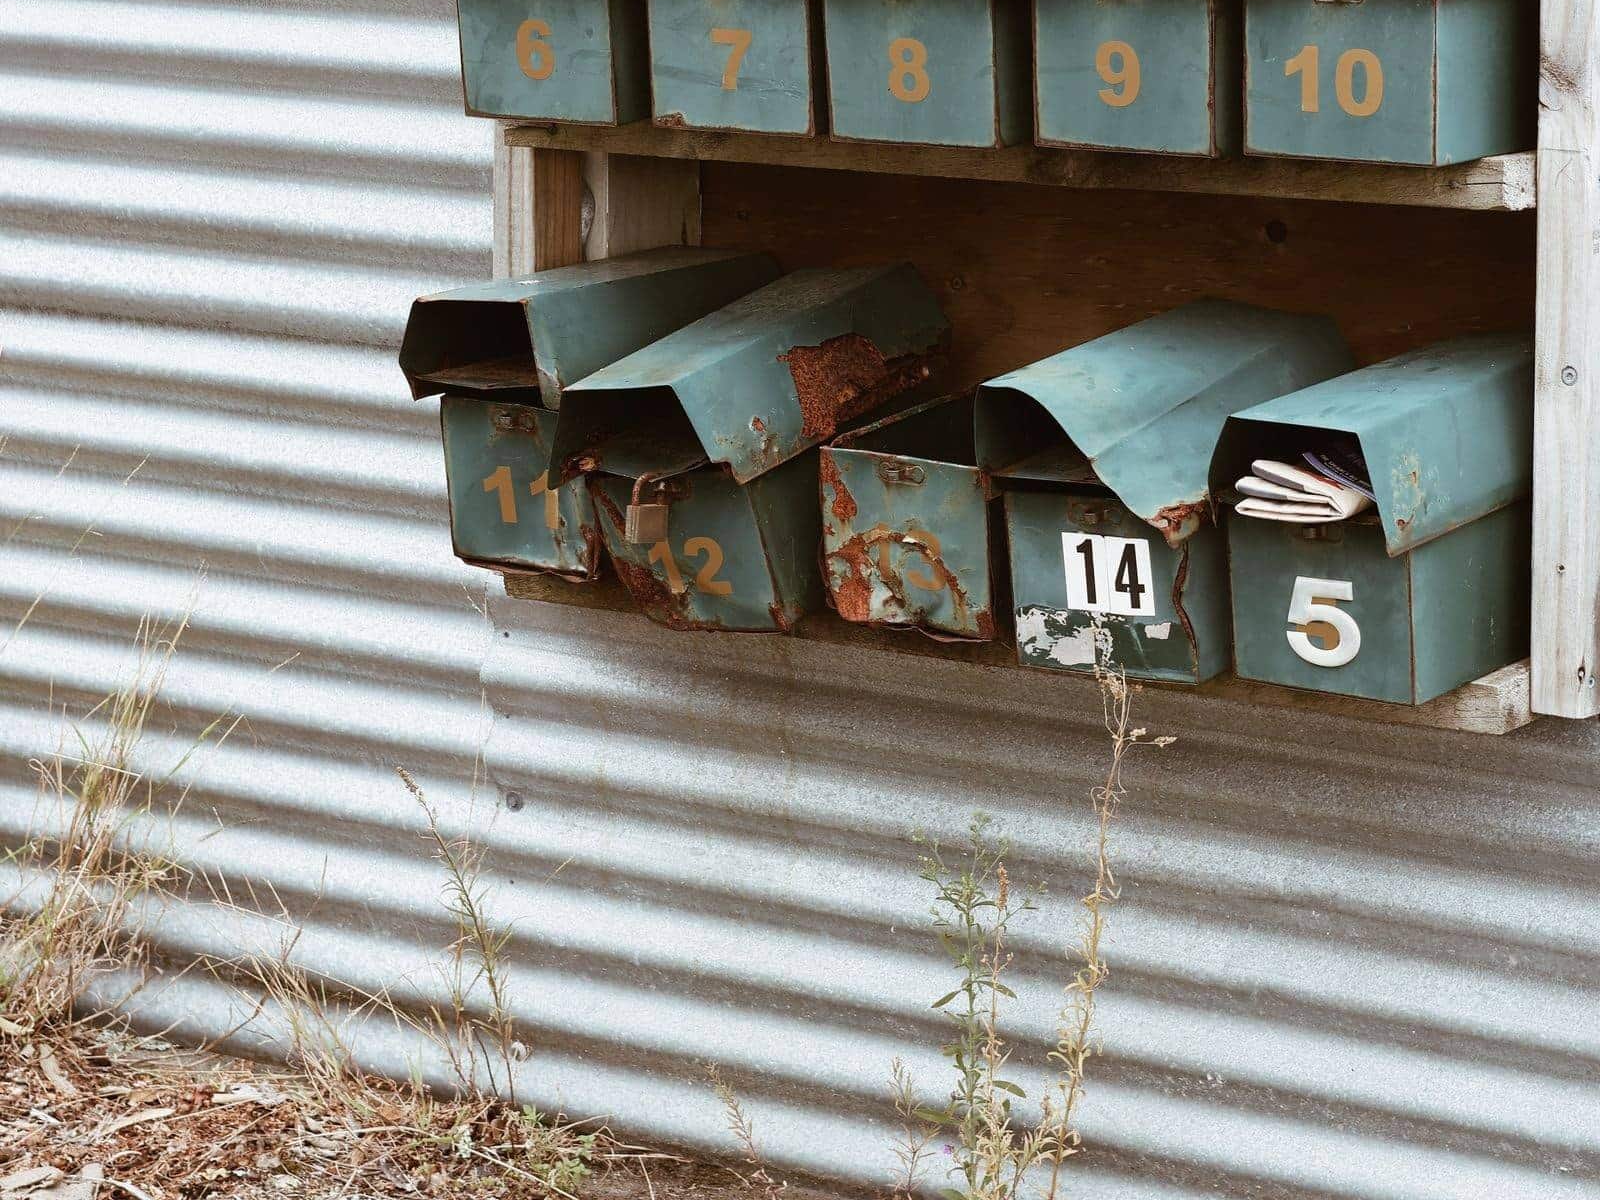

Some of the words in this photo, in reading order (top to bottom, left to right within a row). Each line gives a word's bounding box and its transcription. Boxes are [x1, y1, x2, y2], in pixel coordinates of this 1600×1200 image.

[515, 19, 554, 81] 6
[711, 28, 752, 90] 7
[888, 38, 931, 103] 8
[1095, 40, 1141, 108] 9
[1284, 45, 1384, 117] 10
[482, 465, 561, 531] 11
[647, 536, 733, 595] 12
[1076, 538, 1145, 609] 14
[1286, 576, 1361, 668] 5
